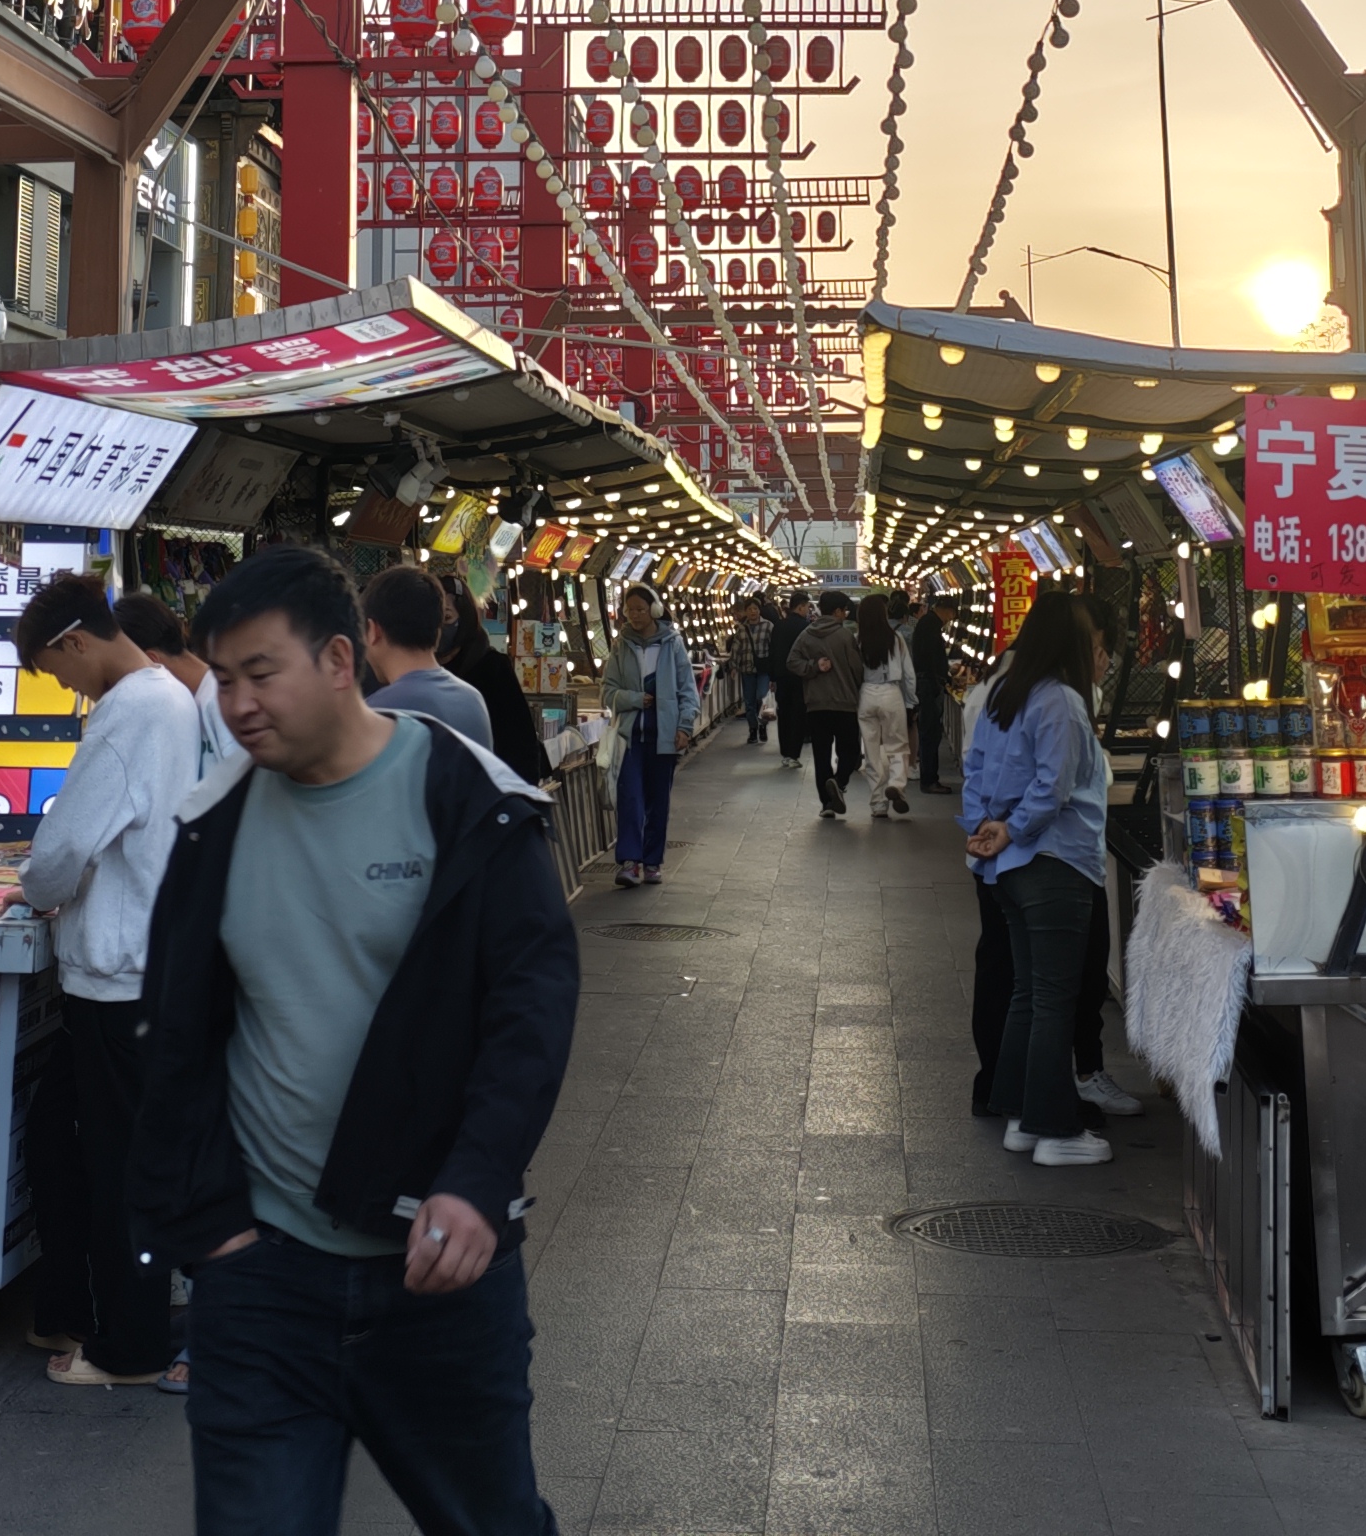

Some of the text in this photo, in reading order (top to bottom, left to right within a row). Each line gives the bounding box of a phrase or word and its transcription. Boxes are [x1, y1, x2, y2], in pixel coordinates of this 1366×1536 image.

[15, 425, 170, 495] 中国体育彩票
[999, 558, 1032, 643] 高价回收
